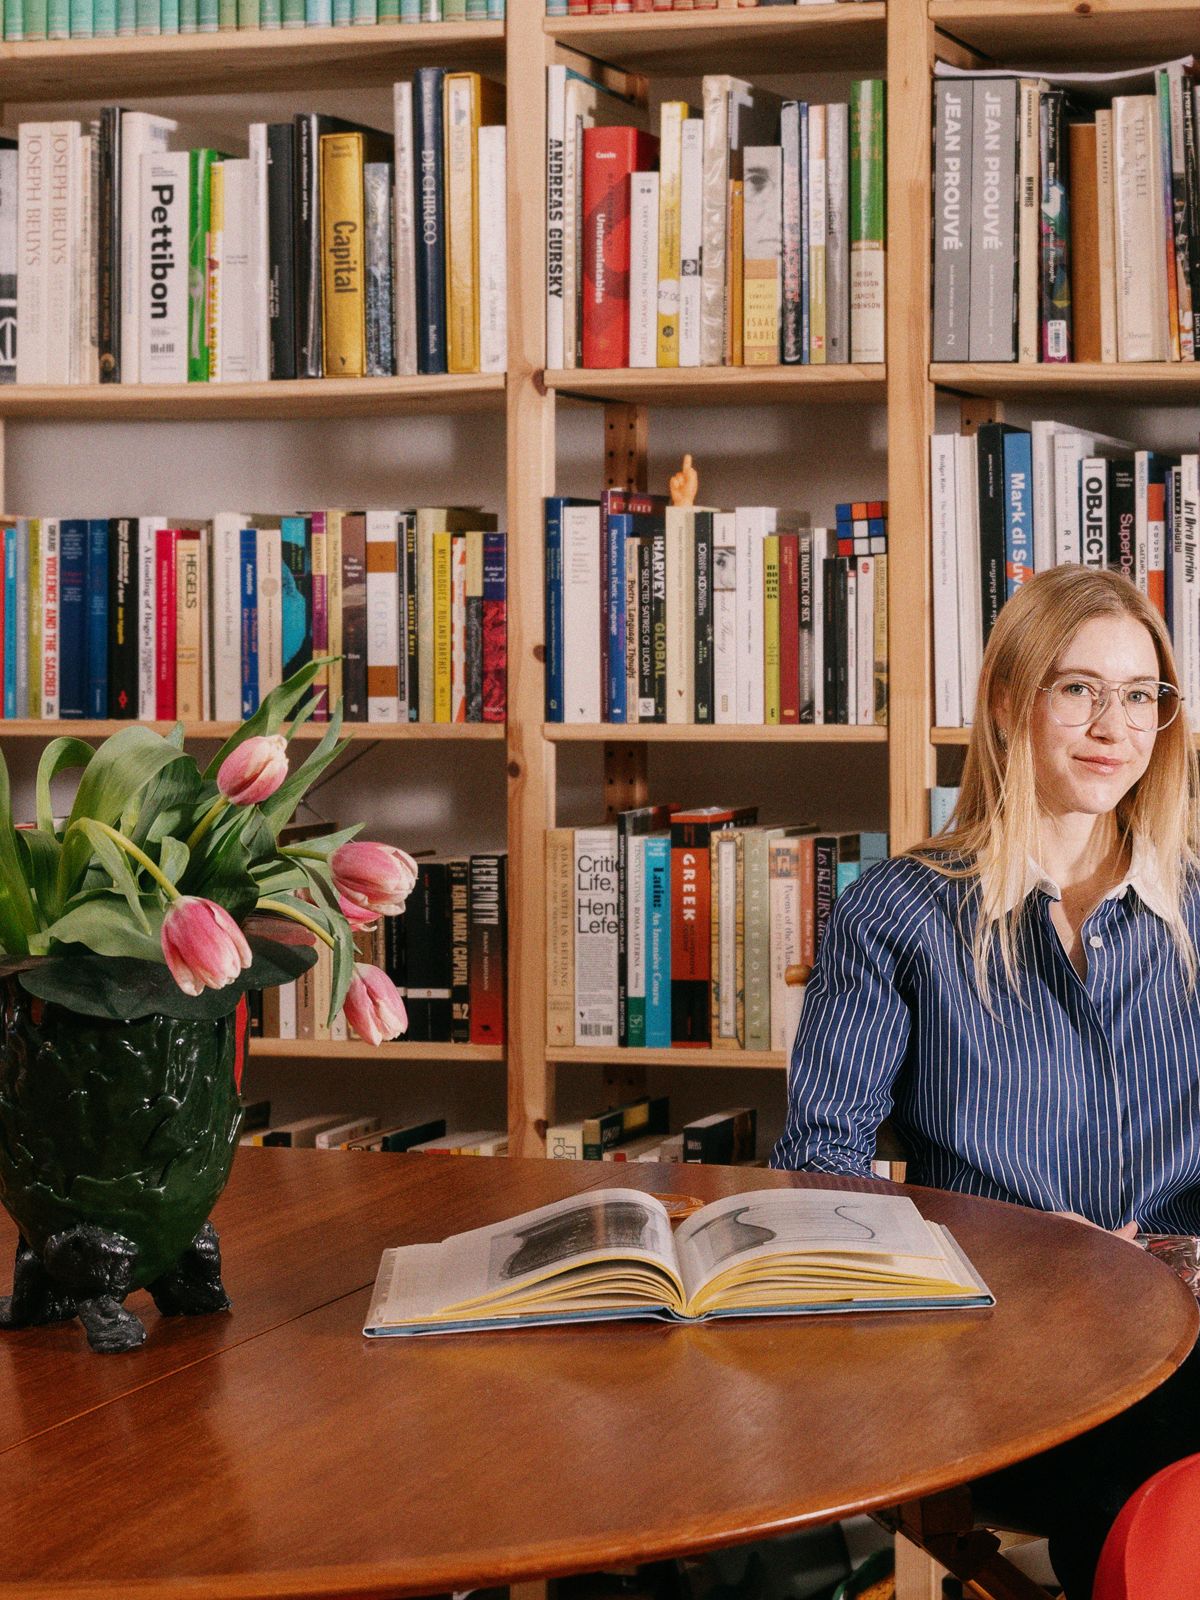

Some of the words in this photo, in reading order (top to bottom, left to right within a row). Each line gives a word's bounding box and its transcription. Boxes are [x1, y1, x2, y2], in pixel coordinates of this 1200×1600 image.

[944, 92, 961, 150] JEAN
[984, 92, 1000, 150] JEAN
[26, 134, 42, 201] JOSEPH
[52, 133, 68, 200] JOSEPH
[422, 150, 436, 171] DE
[550, 138, 564, 220] ANDREAS
[422, 175, 437, 244] CHIRICO
[943, 158, 962, 250] PROUVÉ
[982, 156, 1002, 249] PROUVÉ
[1025, 176, 1034, 208] MEMPHIS
[26, 209, 41, 266] BEUYS
[52, 208, 68, 264] BEUYS
[152, 184, 175, 319] Pettibon
[330, 220, 358, 294] Capital
[548, 228, 562, 298] GURSKY
[596, 214, 606, 303] Untranslatables
[1010, 473, 1025, 521] Mark
[1085, 477, 1103, 566] OBJECT
[1185, 500, 1196, 516] Art
[1011, 527, 1025, 545] di
[1185, 518, 1196, 540] Deco
[45, 557, 56, 603] VIOLENCE
[186, 554, 197, 608] HEGEL'S
[654, 543, 665, 600] HARVEY
[1011, 550, 1026, 590] Suv
[1185, 542, 1196, 583] Interiors
[45, 608, 56, 630] AND
[45, 634, 56, 653] THE
[45, 657, 56, 696] SACRED
[655, 622, 666, 678] GLOBAL
[473, 858, 498, 925] BEHEMOTH
[578, 874, 614, 893] Life,
[653, 868, 664, 907] Latin:
[683, 853, 696, 920] GREEK
[818, 867, 830, 918] FLEURS
